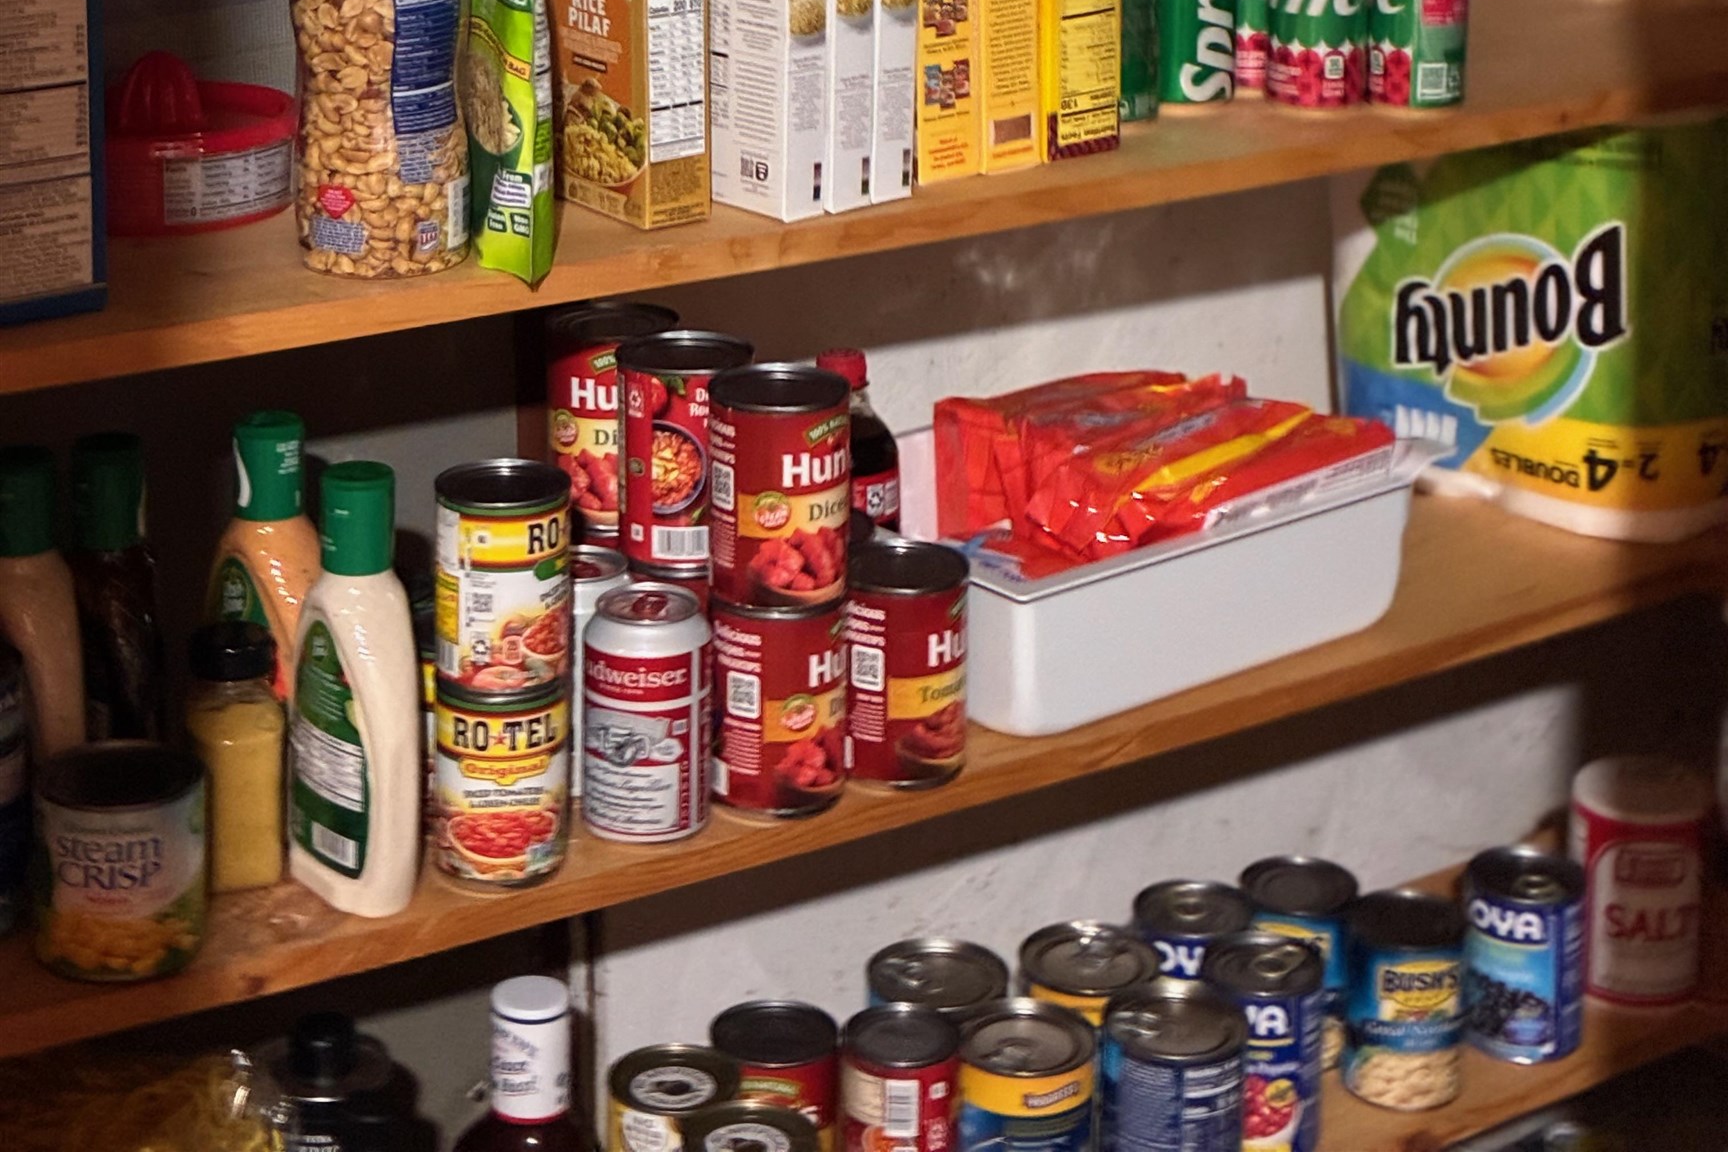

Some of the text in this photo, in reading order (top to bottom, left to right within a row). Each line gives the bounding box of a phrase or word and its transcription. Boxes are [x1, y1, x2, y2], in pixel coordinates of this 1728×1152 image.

[568, 6, 611, 38] PILAF
[1395, 225, 1627, 377] Bounty
[1491, 447, 1581, 489] DOUBLES
[464, 758, 546, 779] Original
[57, 834, 162, 863] steam
[58, 860, 162, 891] CRISP
[1606, 902, 1700, 943] SALT
